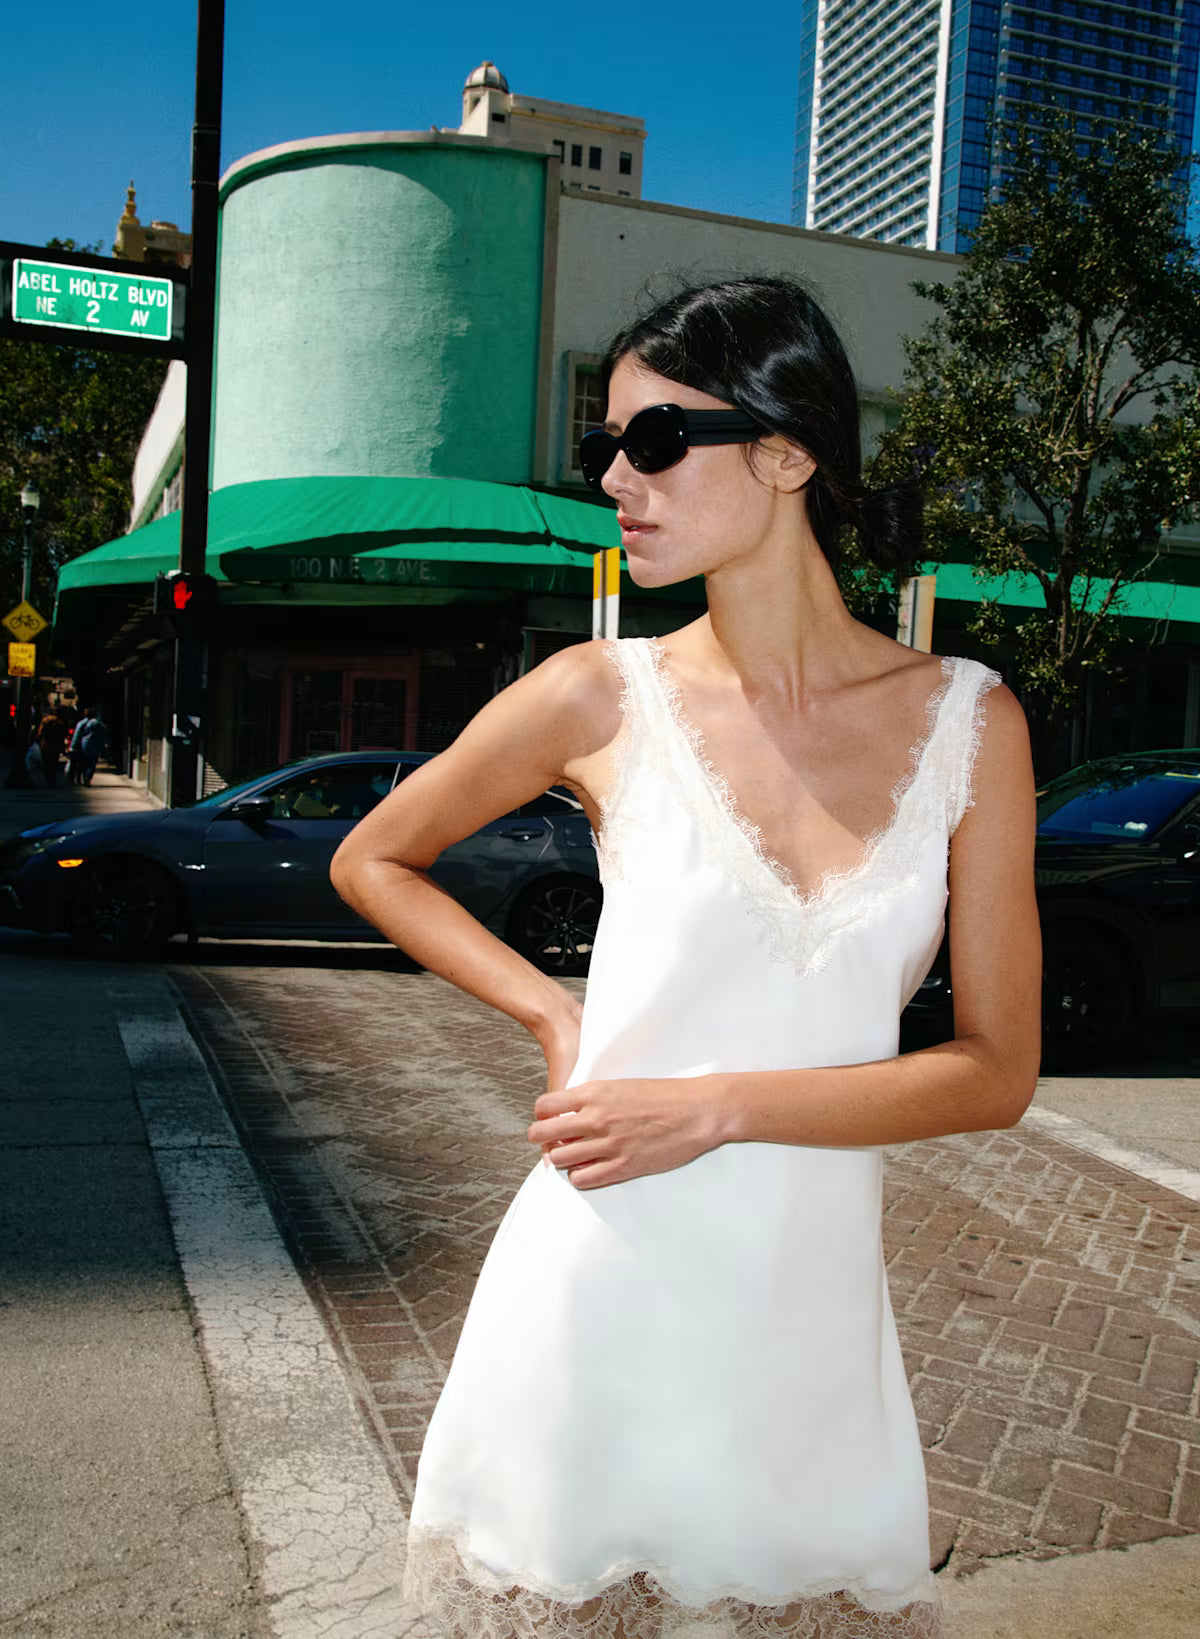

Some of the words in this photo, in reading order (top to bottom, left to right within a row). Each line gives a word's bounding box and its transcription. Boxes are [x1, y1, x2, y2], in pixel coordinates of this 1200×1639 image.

[18, 271, 62, 293] ABEL
[69, 277, 119, 301] HOLTZ
[128, 286, 168, 307] BLVD
[36, 296, 58, 315] NE
[86, 300, 101, 323] 2
[130, 309, 150, 326] AV
[290, 557, 322, 578] 100
[374, 558, 386, 579] 2
